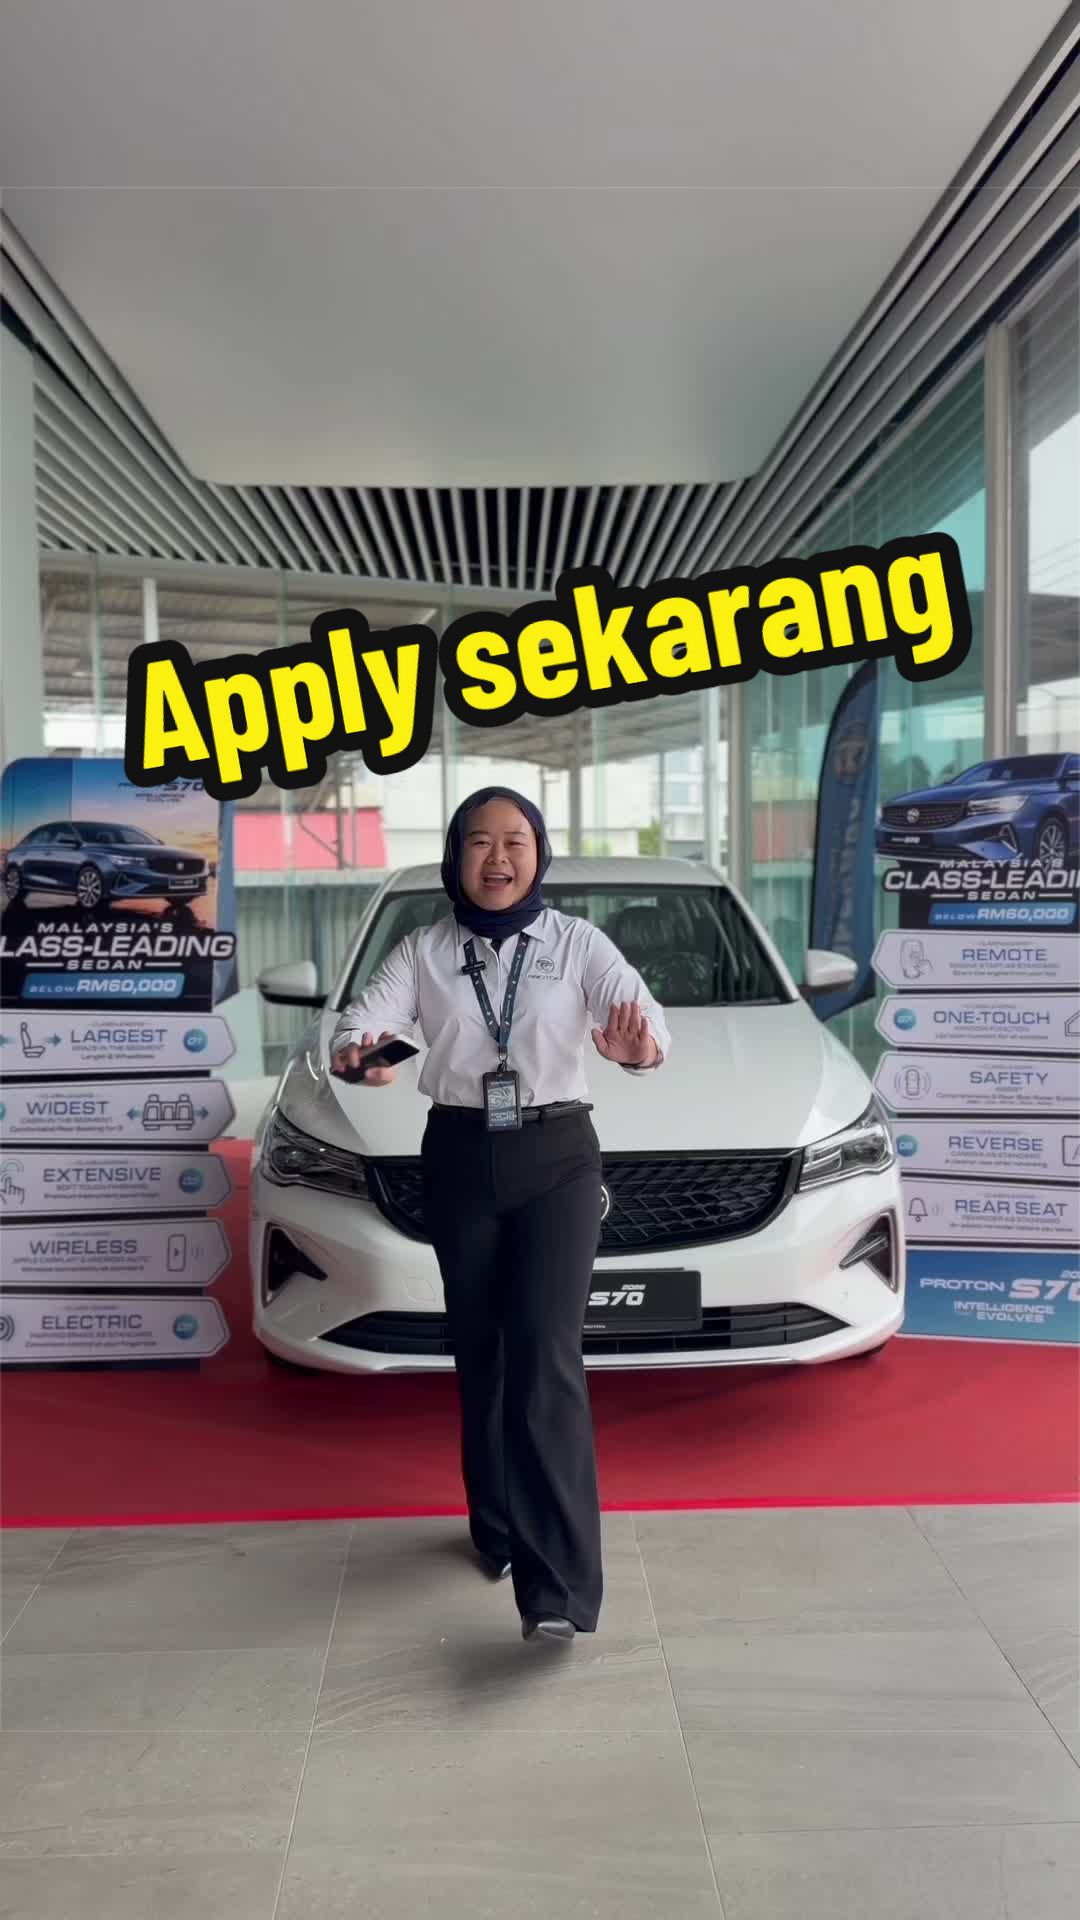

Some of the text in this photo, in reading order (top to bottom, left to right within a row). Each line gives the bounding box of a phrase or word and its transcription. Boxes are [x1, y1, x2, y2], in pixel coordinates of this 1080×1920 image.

[939, 858, 1064, 869] MALAYSIA'S
[884, 870, 1080, 889] CLASS-LEADI
[967, 891, 1036, 900] SEDAN
[977, 908, 1069, 923] RM60,000
[37, 923, 174, 933] MALAYSIA'S
[962, 949, 1048, 961] REMOTE
[66, 960, 143, 970] SEDAN
[29, 979, 177, 994] BELOW RM60,000
[933, 1011, 1050, 1024] ONE-TOUCH
[71, 1029, 168, 1043] LARGEST
[969, 1071, 1049, 1085] SAFETY
[26, 1101, 110, 1115] WIDEST
[949, 1136, 1043, 1151] REVERSE
[43, 1167, 161, 1182] EXTENSIVE
[954, 1200, 1068, 1216] REAR SEAT
[29, 1240, 138, 1255] WIRELESS
[919, 1278, 1005, 1292] PROTON
[588, 1291, 645, 1305] S70
[953, 1301, 1054, 1315] INTELLIGENCE
[41, 1315, 143, 1330] ELECTRIC
[976, 1312, 1045, 1324] EVOLVES
